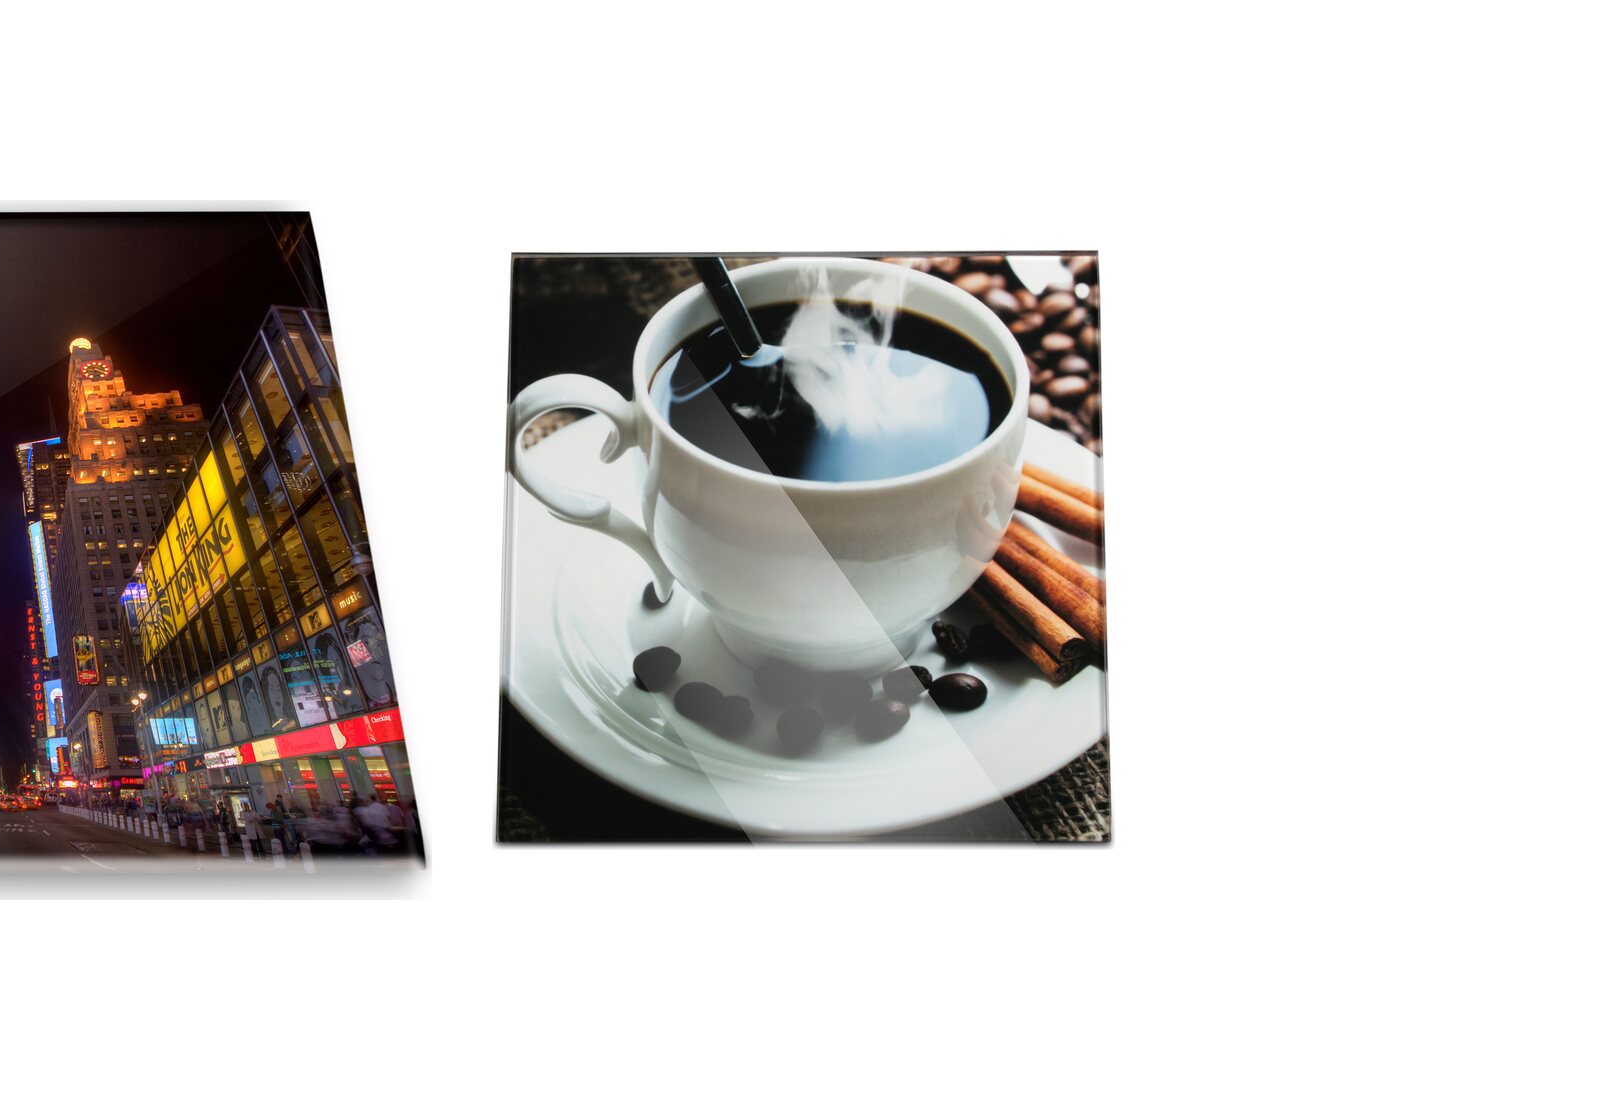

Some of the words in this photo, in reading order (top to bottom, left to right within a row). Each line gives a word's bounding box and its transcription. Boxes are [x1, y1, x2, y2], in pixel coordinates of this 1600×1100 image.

[176, 515, 196, 552] THE
[169, 560, 197, 616] LION
[191, 517, 233, 587] KING
[339, 590, 362, 609] music
[27, 607, 37, 651] ERNST
[31, 657, 39, 666] &
[33, 673, 46, 722] YOUNG
[370, 713, 392, 724] Checking
